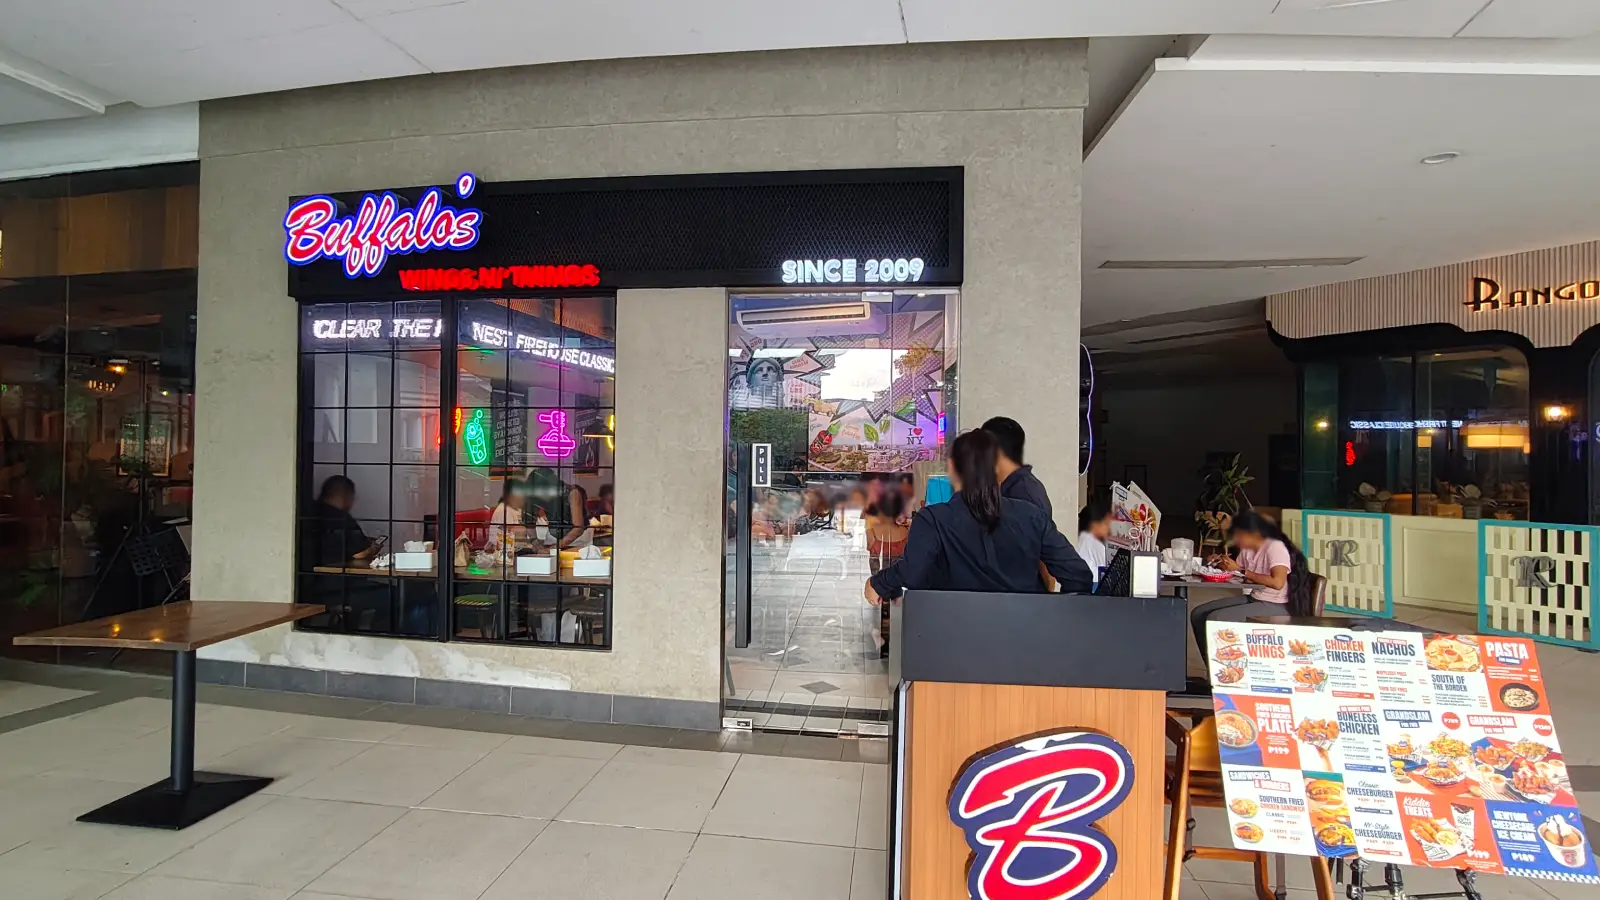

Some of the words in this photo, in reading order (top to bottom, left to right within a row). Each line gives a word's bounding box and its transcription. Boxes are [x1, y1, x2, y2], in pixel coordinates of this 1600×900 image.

[284, 173, 482, 278] Buffalo's
[781, 259, 857, 284] SINCE
[864, 257, 924, 283] 2009
[399, 268, 480, 291] WINGS
[511, 264, 600, 288] THINGS
[313, 318, 381, 339] CLEAR
[391, 318, 435, 339] THE
[579, 349, 615, 374] CLASSIC
[906, 437, 924, 445] NY
[1246, 633, 1284, 646] BUFFALO
[1325, 639, 1364, 652] CHICKEN
[1247, 643, 1285, 659] WINGS
[1371, 641, 1416, 657] NACHOS
[1485, 641, 1530, 660] PASTA
[1326, 650, 1366, 664] FINGERS
[1431, 674, 1455, 684] SOUTH
[1456, 675, 1465, 685] OF
[1445, 684, 1467, 692] BORDER
[1337, 711, 1378, 724] BONELESS
[1258, 718, 1294, 734] PLATE
[1340, 722, 1380, 735] CHICKEN
[1347, 787, 1394, 798] CHEESEBURGER
[1259, 795, 1288, 804] SOUTHERN
[1288, 797, 1305, 805] FRIED
[1404, 796, 1430, 807] Kiddie
[1405, 806, 1433, 817] TREATS
[1355, 829, 1403, 840] CHEESEBURGER
